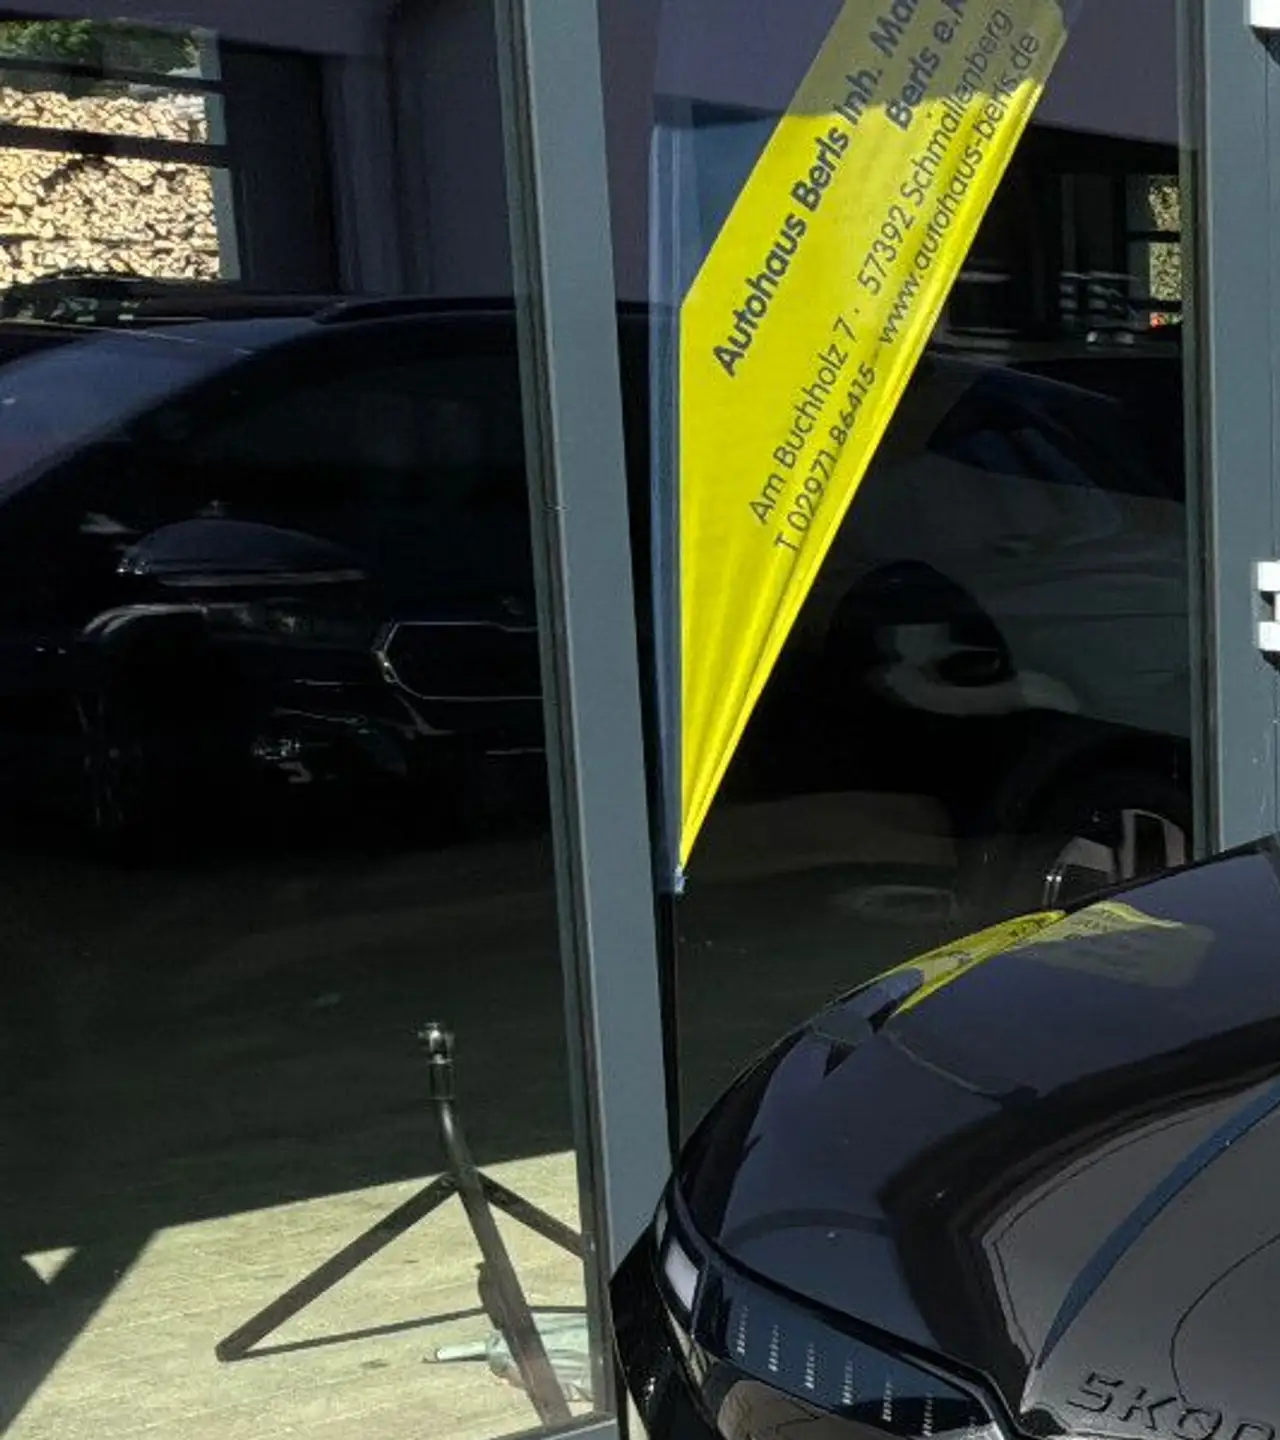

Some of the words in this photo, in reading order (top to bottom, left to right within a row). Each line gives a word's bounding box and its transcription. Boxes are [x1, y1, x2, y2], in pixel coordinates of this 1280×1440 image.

[713, 213, 807, 377] Autohaus
[791, 126, 849, 212] Berls
[833, 68, 883, 125] Inh.
[750, 473, 786, 524] Am
[773, 343, 848, 469] Buchholz
[832, 316, 858, 343] 7
[857, 203, 914, 295] 57392
[901, 9, 1013, 206] Schmallenberg
[774, 531, 799, 552] T
[787, 449, 837, 532] 02971
[829, 361, 875, 446] 86415
[878, 33, 1040, 344] www.autohaus-berls.de
[885, 47, 940, 131] Berls
